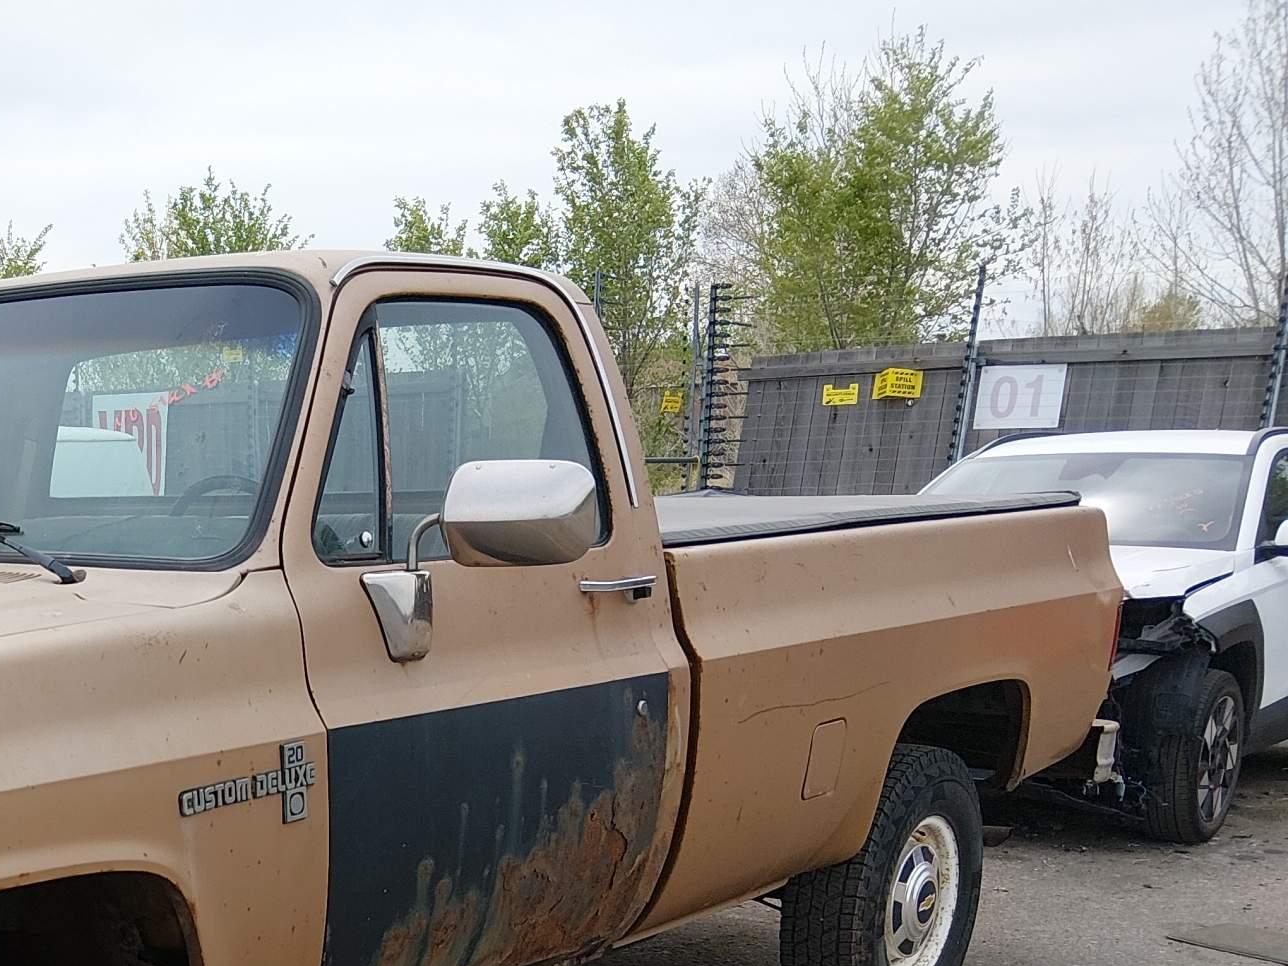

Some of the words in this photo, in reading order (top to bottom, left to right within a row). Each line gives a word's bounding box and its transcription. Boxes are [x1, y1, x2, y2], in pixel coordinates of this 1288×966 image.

[890, 382, 916, 390] STATION
[990, 374, 1045, 418] 01
[286, 745, 304, 764] 20
[180, 776, 252, 817] CUSTOM
[255, 762, 317, 797] DELUXE
